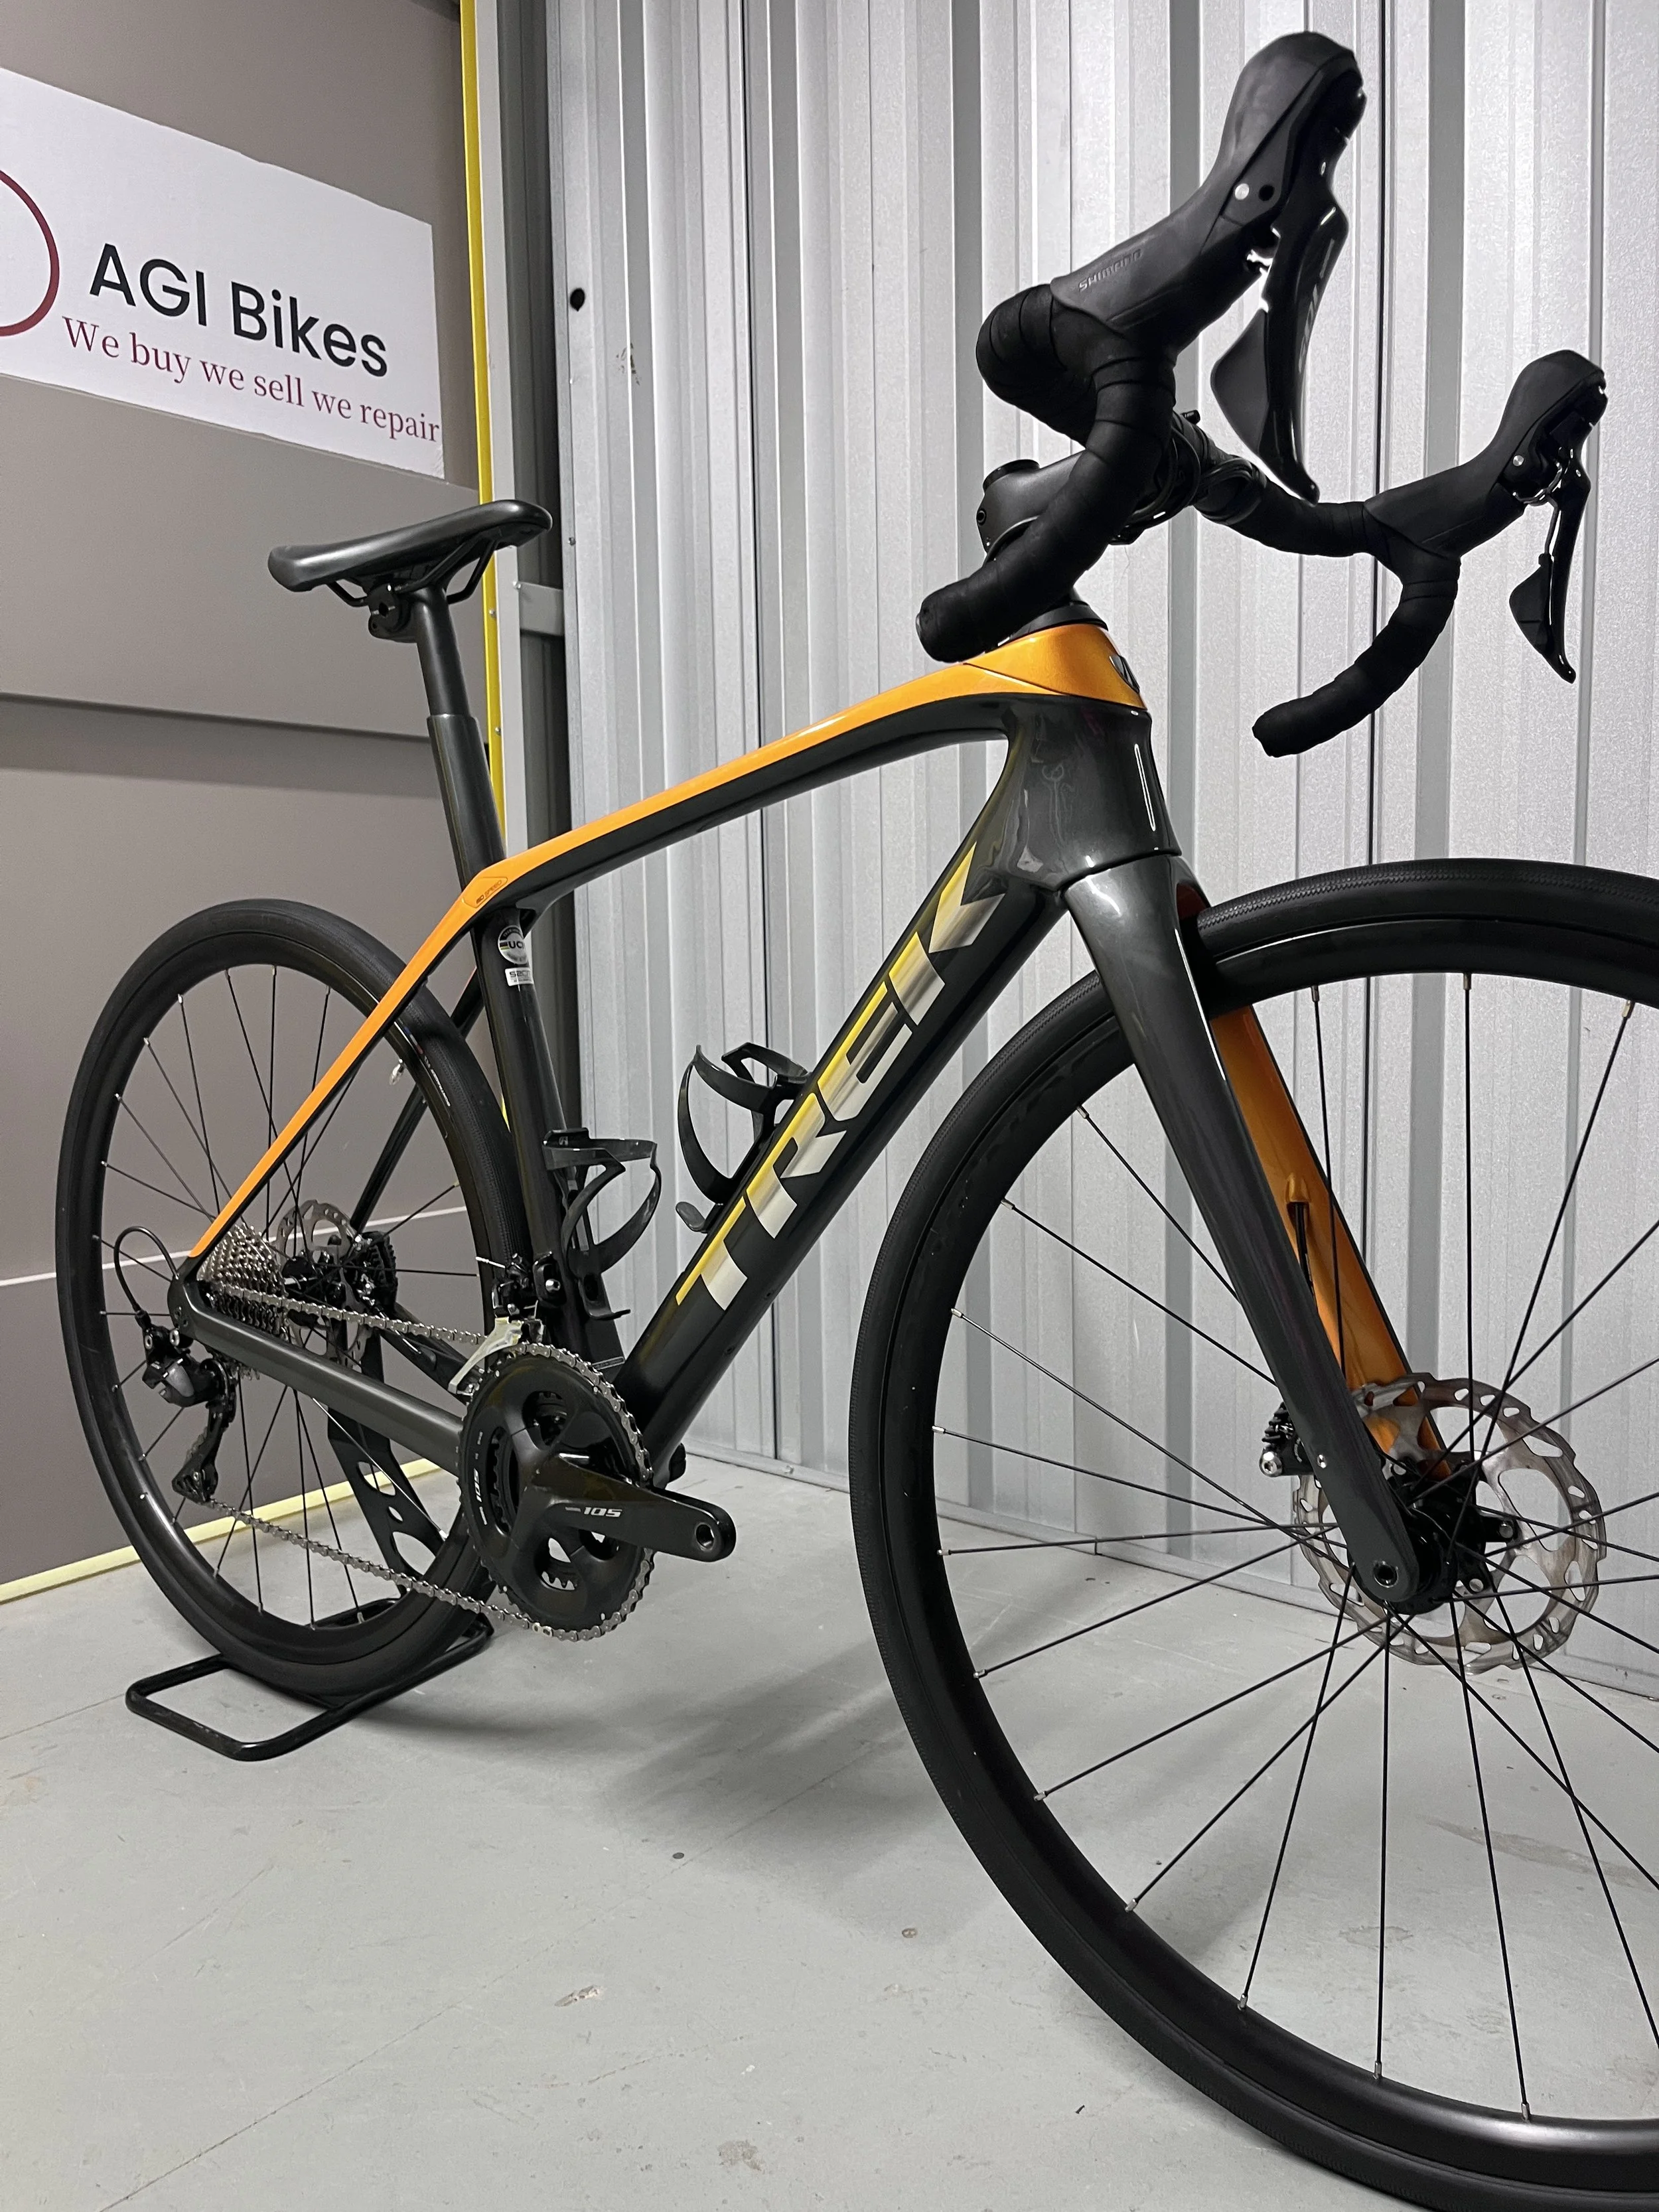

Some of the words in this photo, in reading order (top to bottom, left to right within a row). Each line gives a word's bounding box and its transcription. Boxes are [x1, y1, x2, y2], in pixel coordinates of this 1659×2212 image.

[90, 243, 207, 327] AGI
[231, 280, 388, 378] Bikes
[1078, 249, 1143, 292] SHIMANO
[62, 315, 120, 358] We
[129, 332, 192, 383] buy
[199, 358, 245, 391] we
[253, 374, 303, 407] sell
[311, 387, 352, 419] we
[360, 402, 440, 442] repair
[676, 841, 1006, 1311] TREK
[583, 1506, 623, 1518] 105
